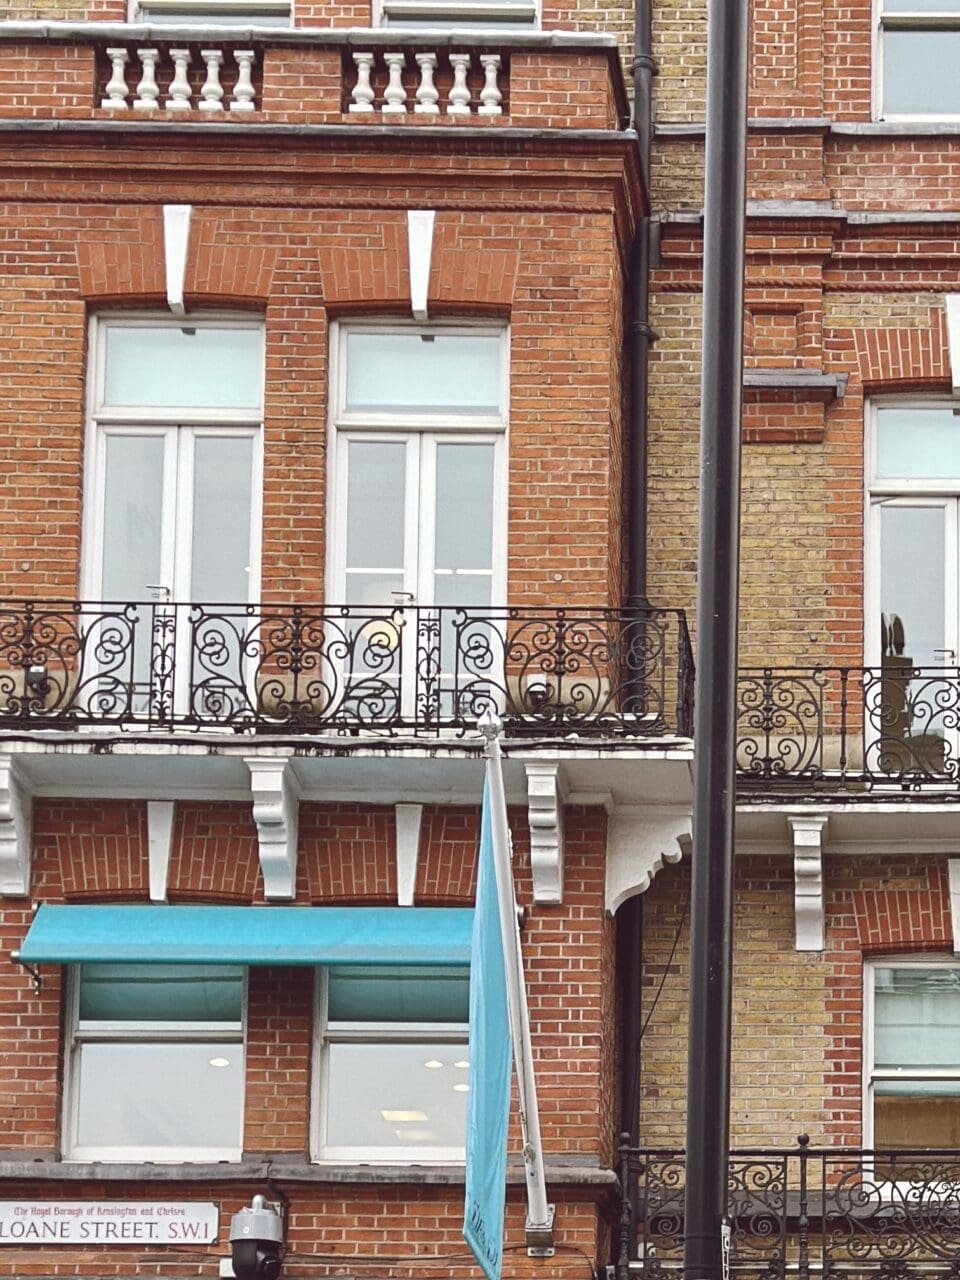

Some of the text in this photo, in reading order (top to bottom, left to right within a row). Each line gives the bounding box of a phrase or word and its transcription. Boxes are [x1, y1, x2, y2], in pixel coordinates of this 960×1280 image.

[14, 1206, 185, 1218] The Royal Borough of Kensington and Chelsea
[0, 1221, 71, 1238] LOANE
[80, 1221, 159, 1239] STREET.
